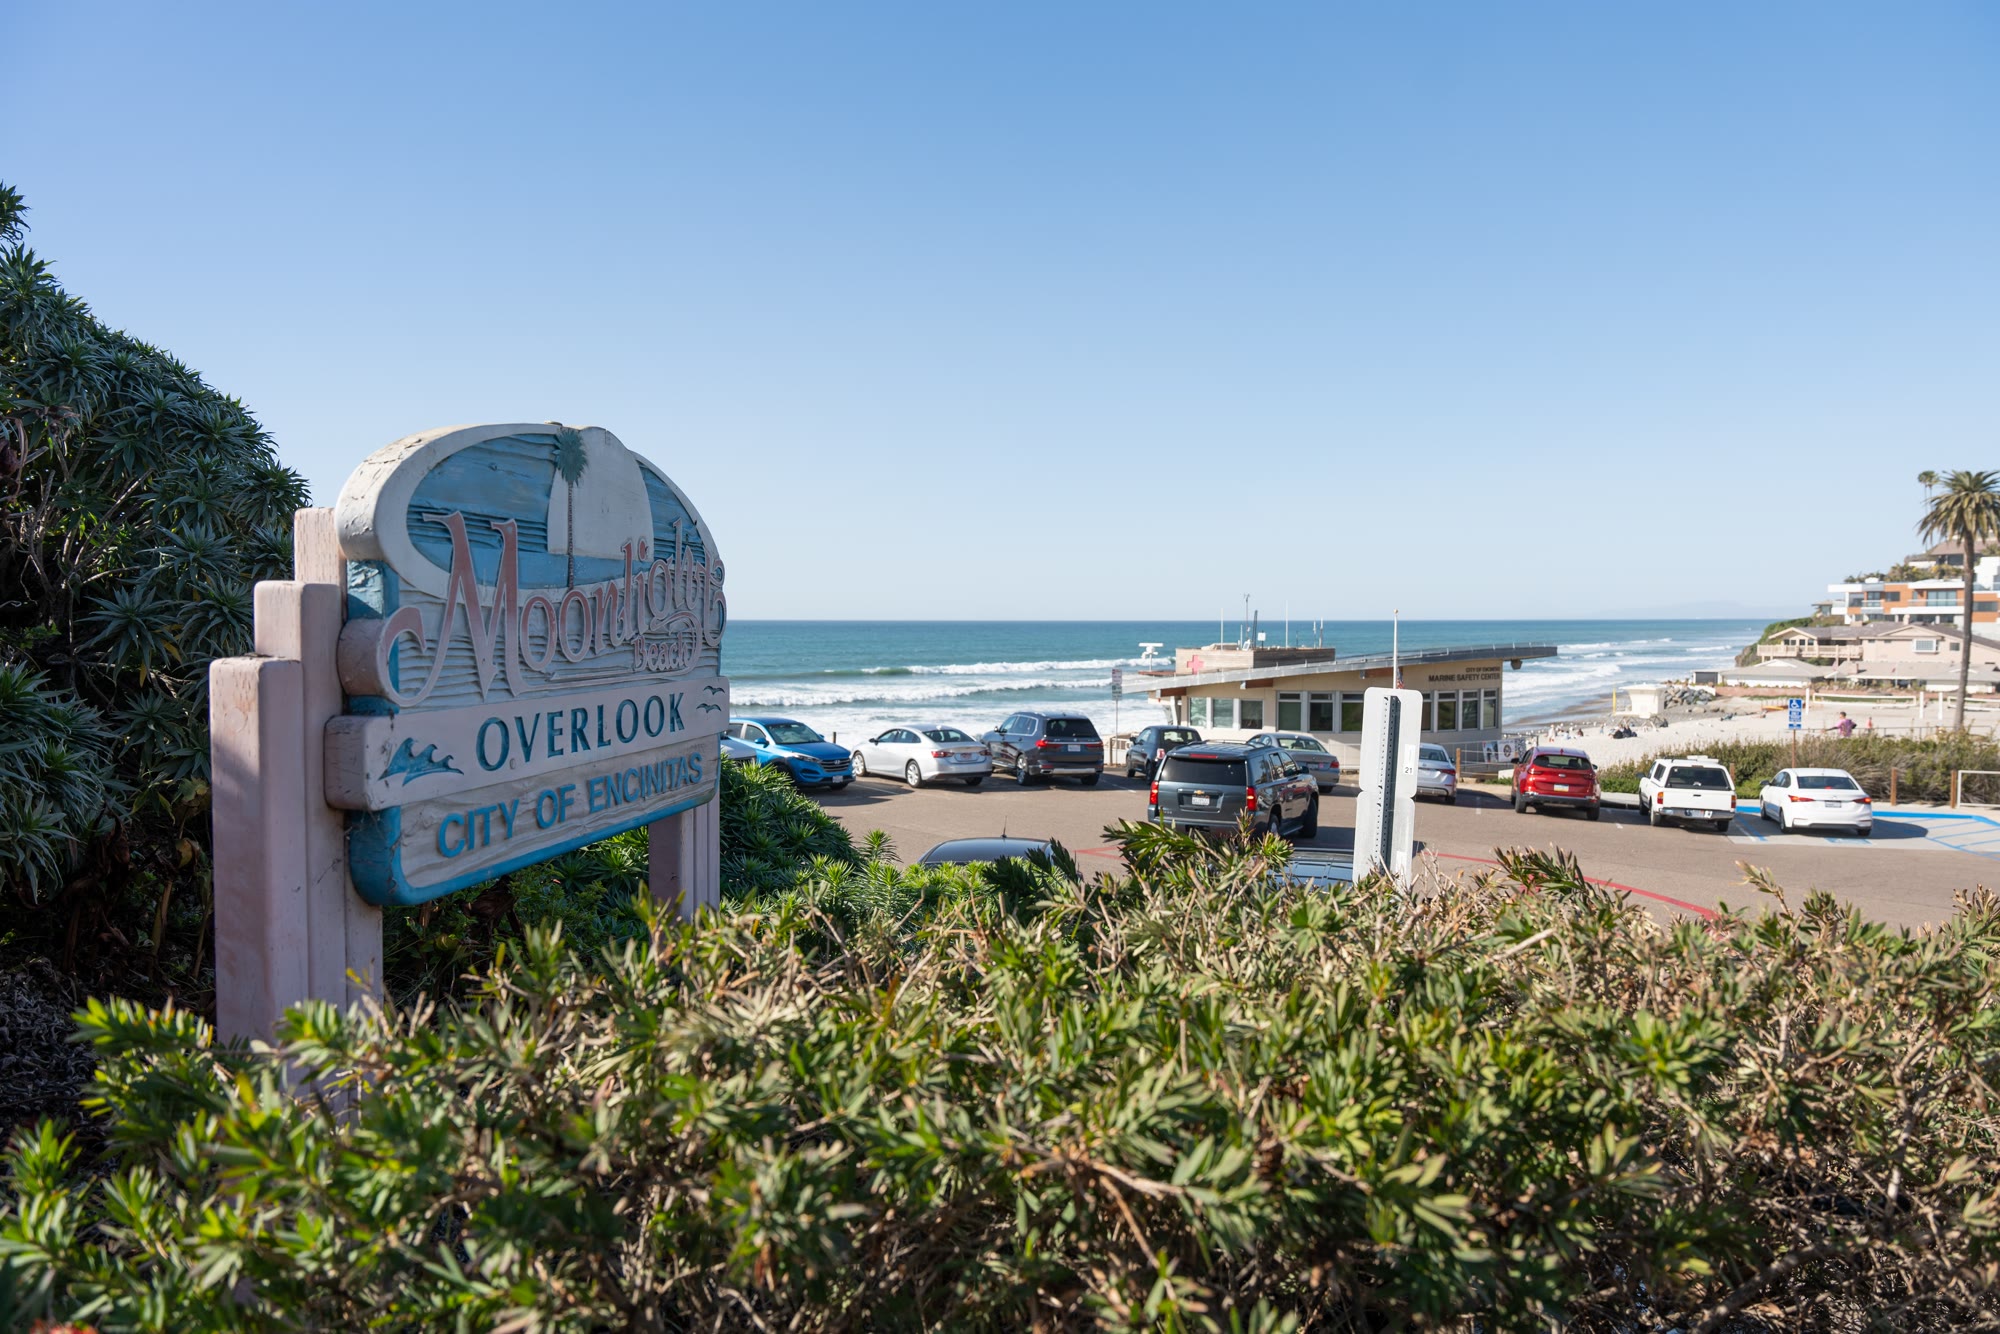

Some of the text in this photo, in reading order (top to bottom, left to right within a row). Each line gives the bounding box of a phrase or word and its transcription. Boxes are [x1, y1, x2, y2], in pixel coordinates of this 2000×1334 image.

[376, 510, 726, 708] Moonlight
[631, 632, 693, 671] Beach
[1457, 673, 1480, 681] SAFETY
[1481, 672, 1500, 680] CENTER
[475, 691, 686, 773] OVERLOOK
[437, 751, 704, 859] CITY OF ENCINITAS
